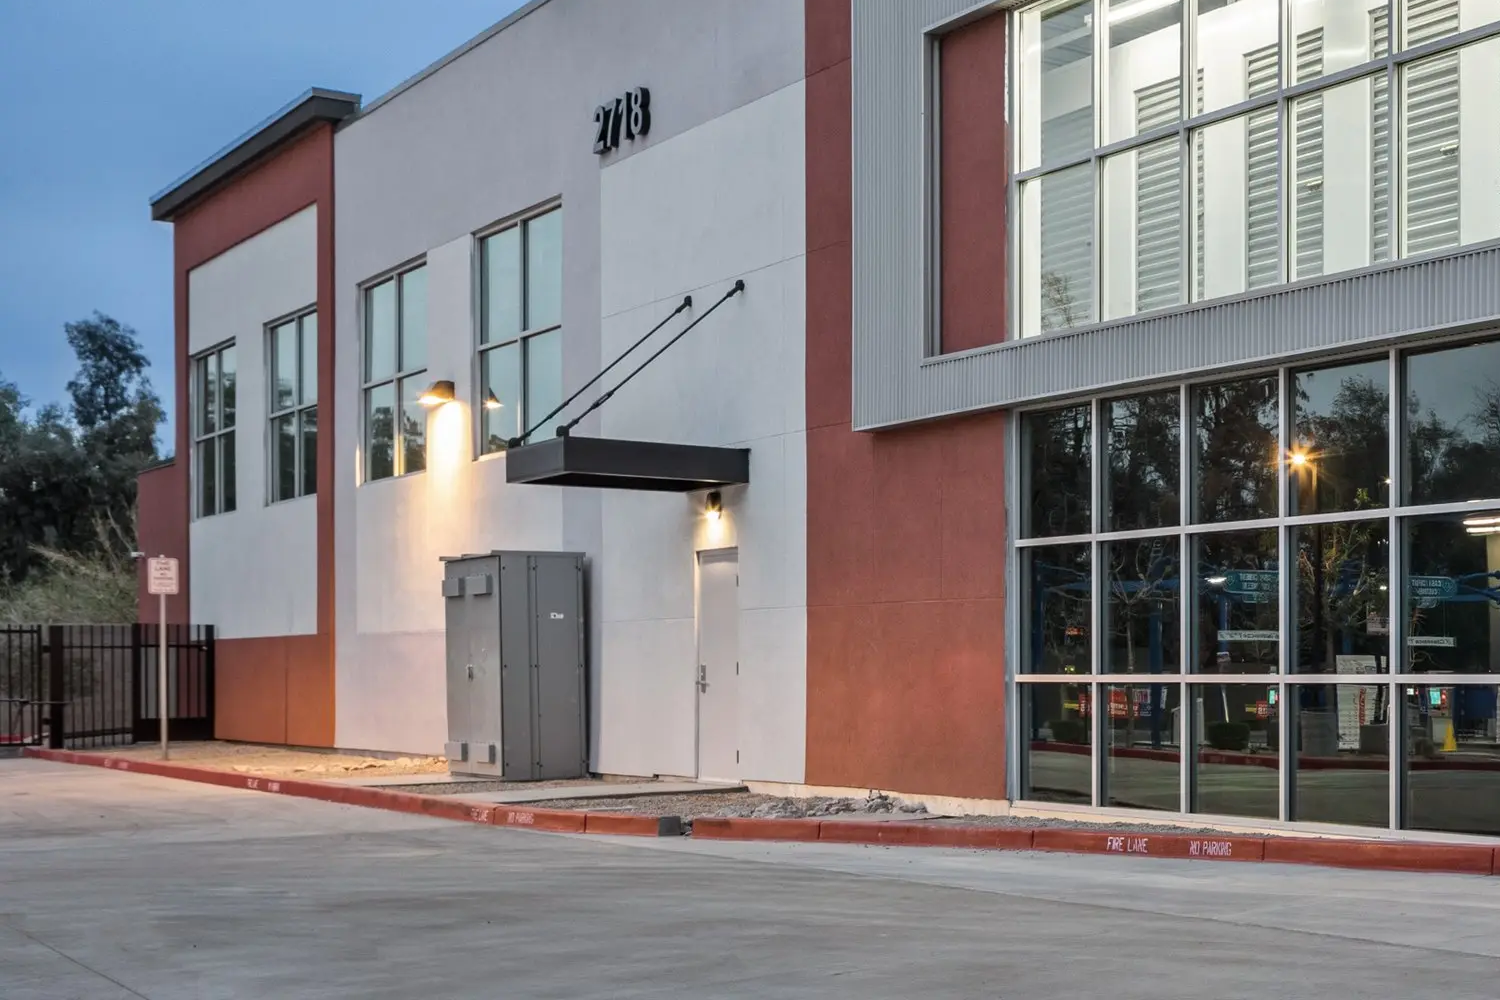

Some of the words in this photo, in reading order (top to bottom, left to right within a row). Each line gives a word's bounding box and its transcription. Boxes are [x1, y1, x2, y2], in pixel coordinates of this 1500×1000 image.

[592, 86, 651, 155] 2718
[1106, 836, 1125, 851] FIRE
[1127, 837, 1149, 853] LANE
[1189, 840, 1200, 855] NO
[1202, 840, 1232, 856] PARKING
